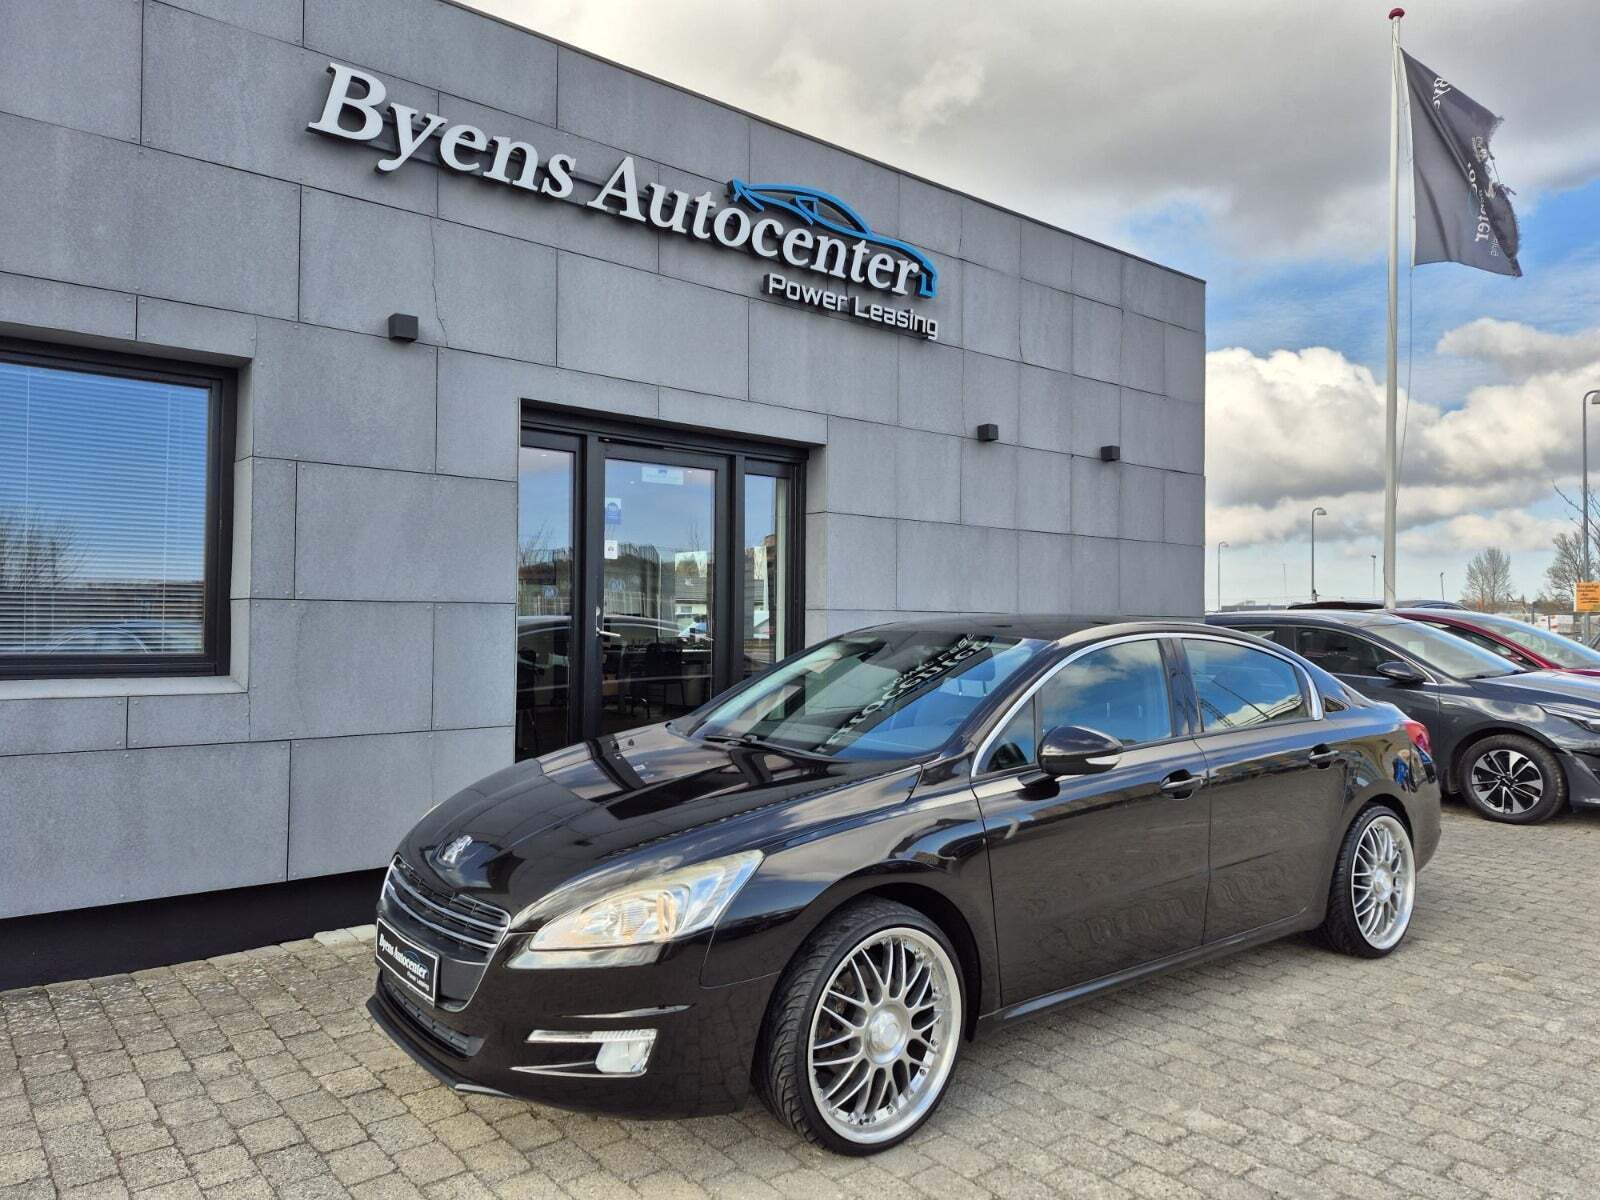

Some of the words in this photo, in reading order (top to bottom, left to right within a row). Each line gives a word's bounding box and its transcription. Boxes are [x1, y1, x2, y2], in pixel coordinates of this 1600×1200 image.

[307, 62, 577, 199] Byens
[586, 156, 920, 296] Autocenter
[766, 272, 848, 312] Power
[854, 295, 939, 341] Leasing
